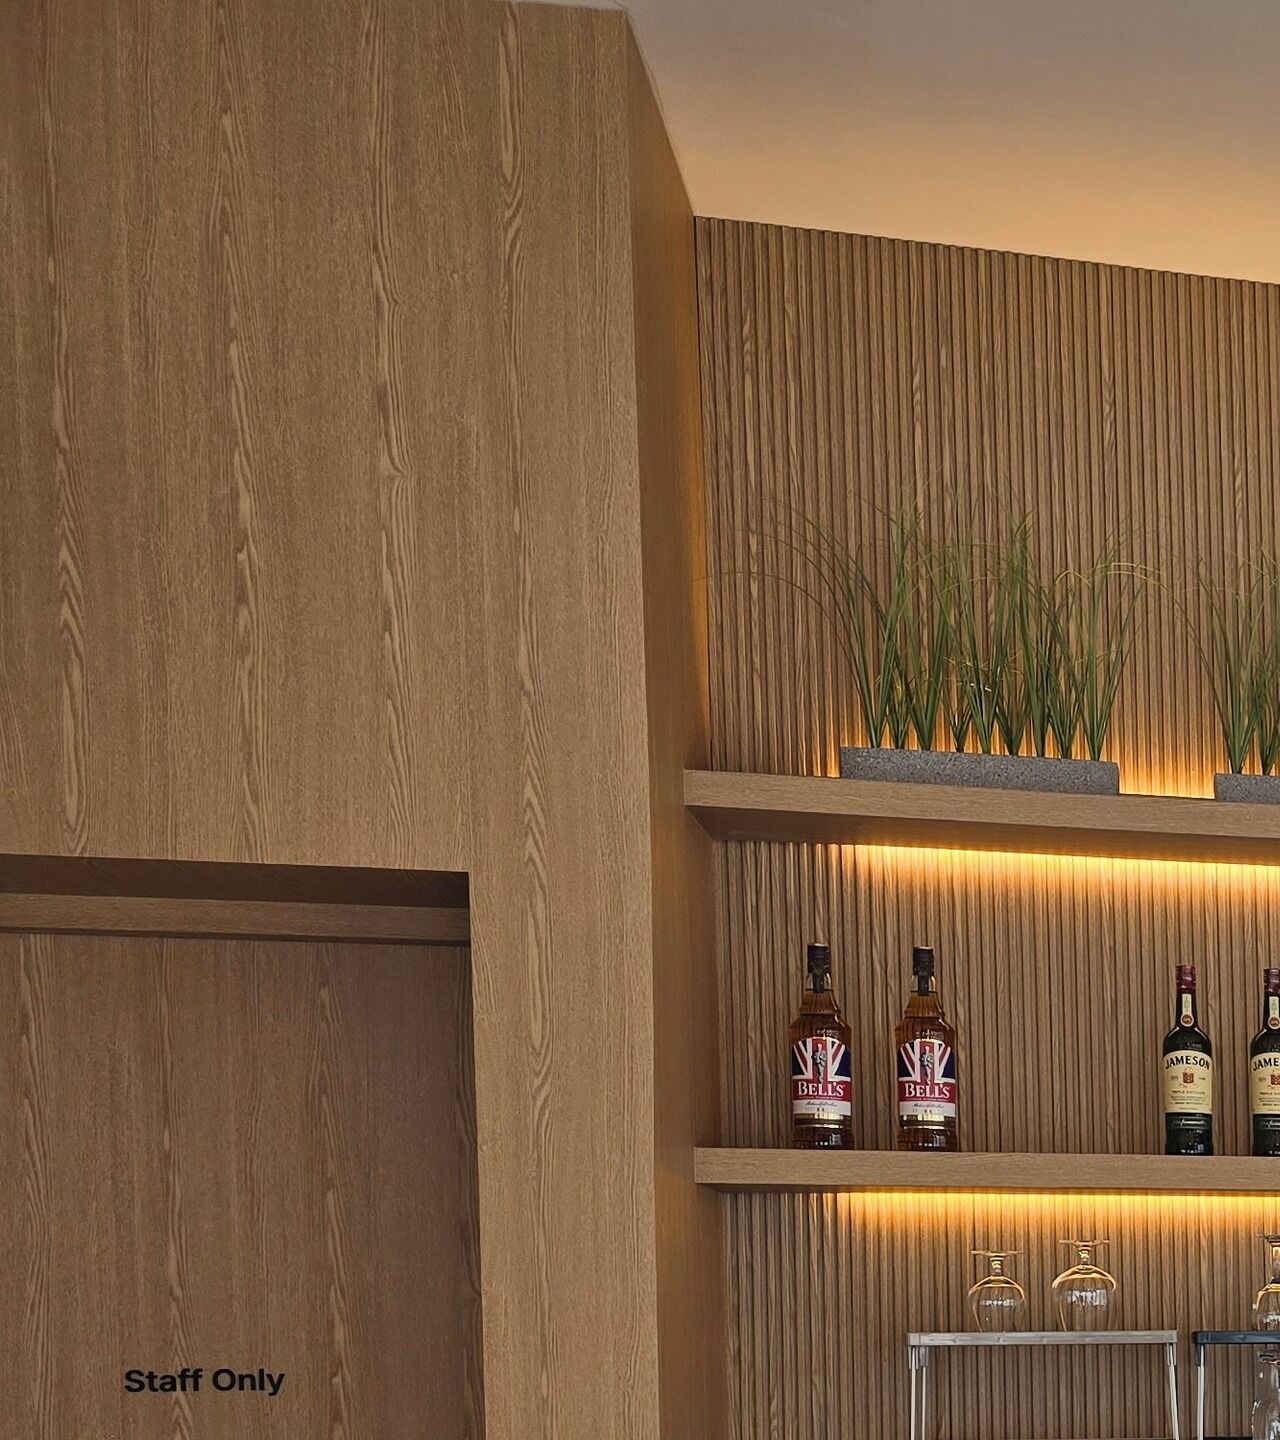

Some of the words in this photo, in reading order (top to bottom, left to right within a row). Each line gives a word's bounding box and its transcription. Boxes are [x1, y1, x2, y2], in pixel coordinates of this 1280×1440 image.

[1165, 1055, 1210, 1071] JAMESON
[797, 1081, 844, 1097] BELL'S
[905, 1083, 950, 1099] BELL'S
[124, 1368, 203, 1393] Staff
[212, 1368, 285, 1397] Only
